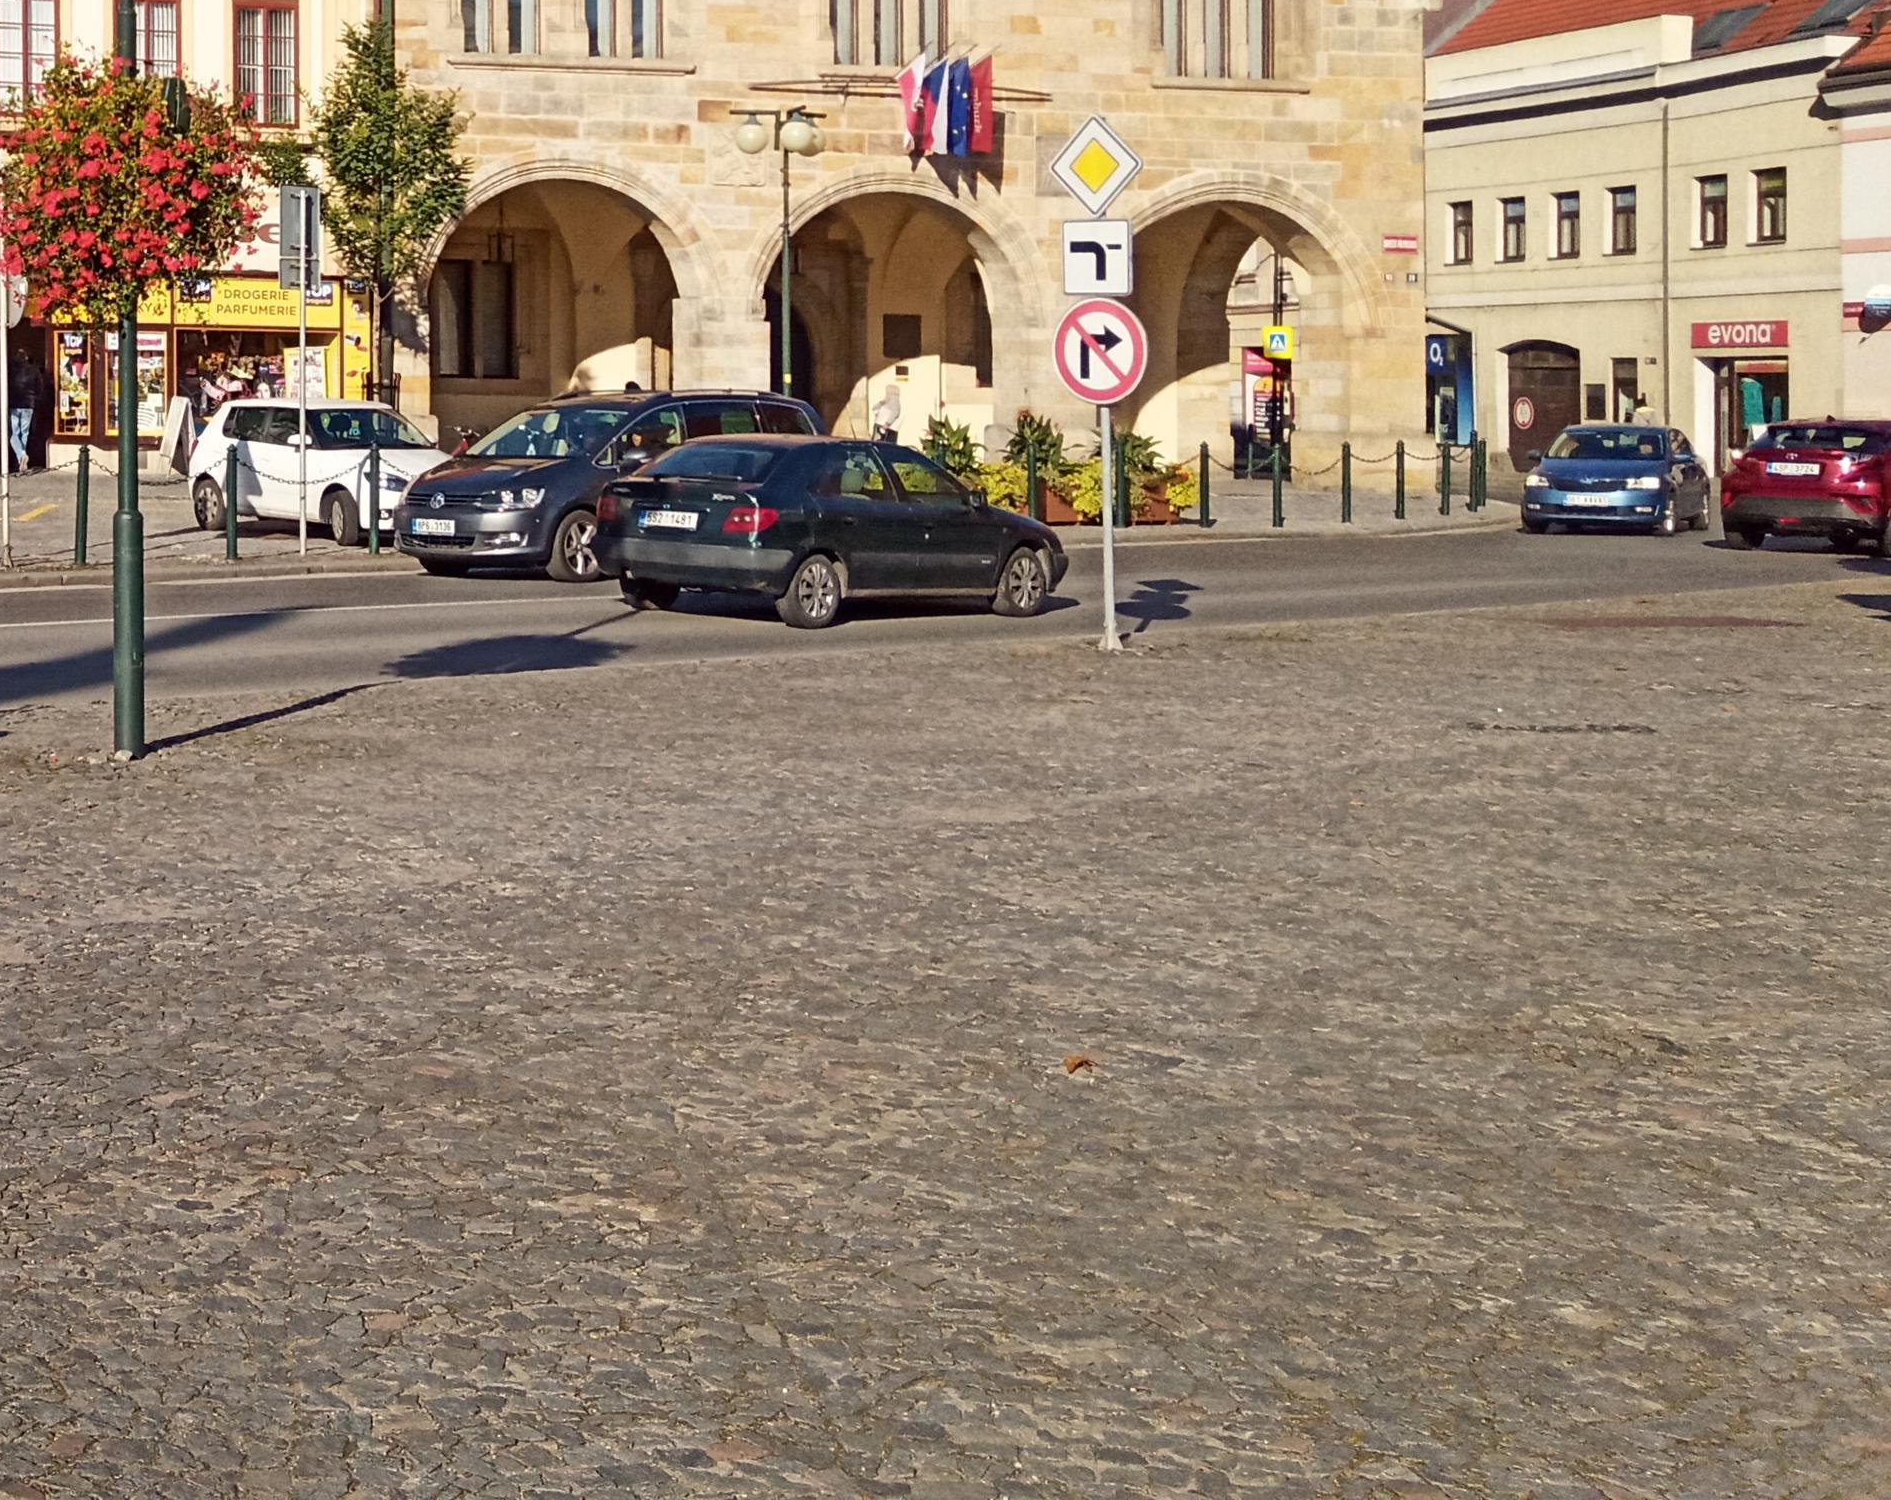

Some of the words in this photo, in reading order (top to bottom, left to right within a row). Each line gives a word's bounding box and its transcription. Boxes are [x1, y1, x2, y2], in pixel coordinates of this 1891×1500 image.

[224, 289, 289, 301] DROGERIE
[216, 304, 297, 316] PARFUMERIE
[1708, 324, 1772, 344] evona
